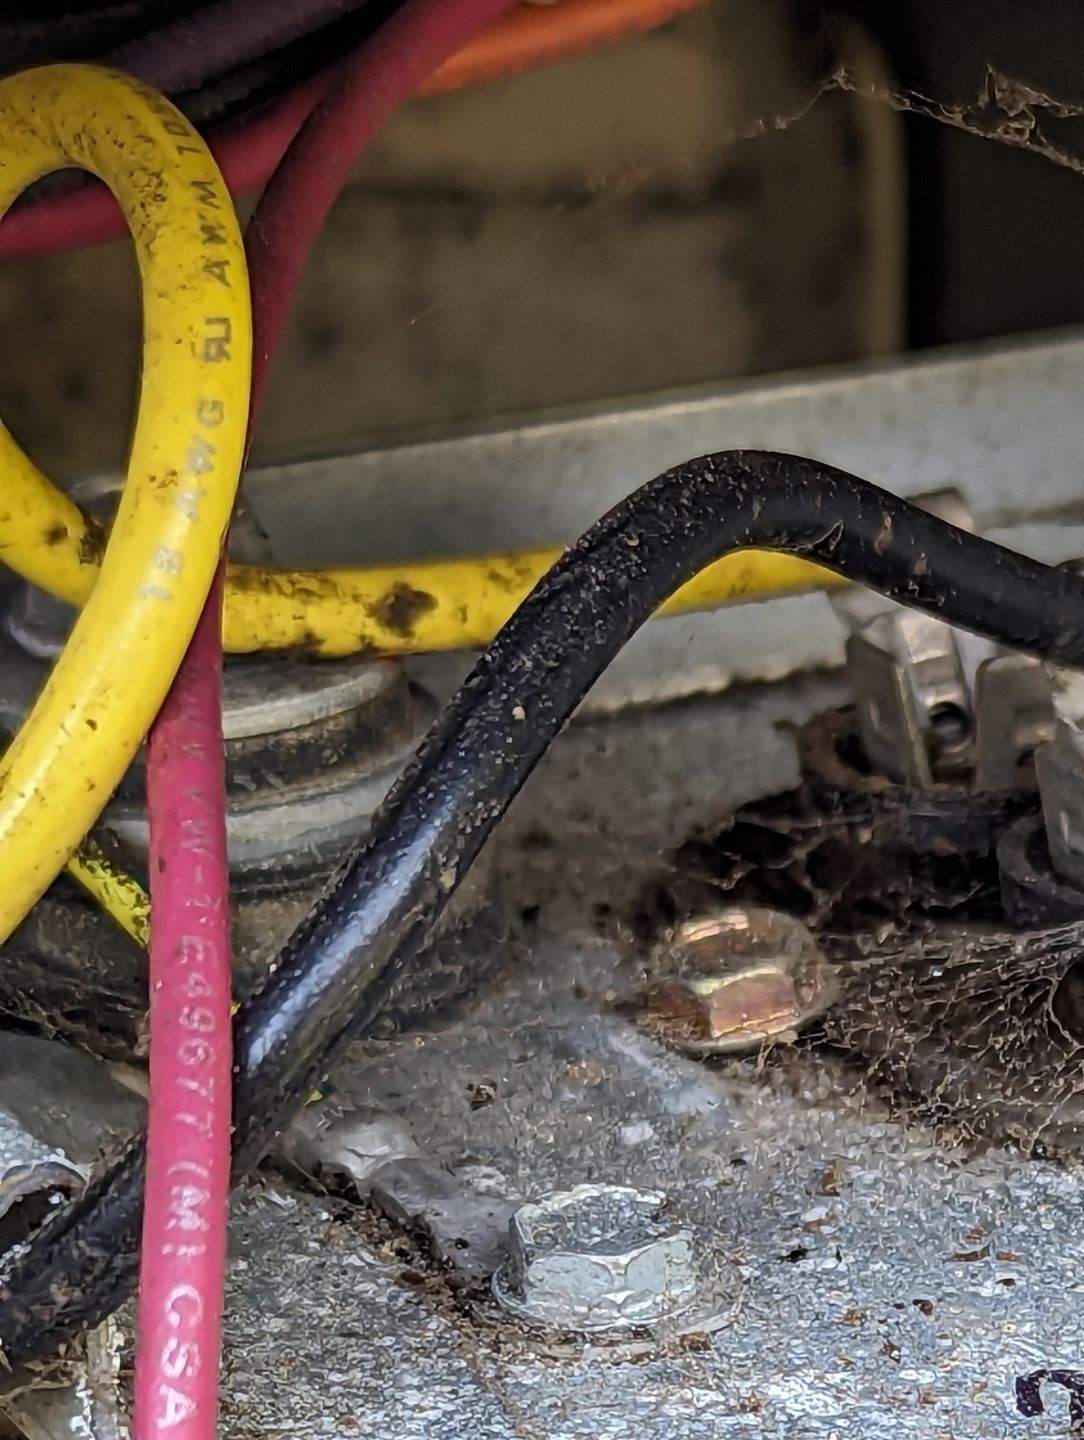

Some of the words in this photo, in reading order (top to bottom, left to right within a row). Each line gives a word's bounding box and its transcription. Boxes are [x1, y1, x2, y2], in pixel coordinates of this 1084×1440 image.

[176, 396, 225, 522] AWG
[172, 934, 220, 1138] E49677
[157, 1284, 202, 1429] CSA
